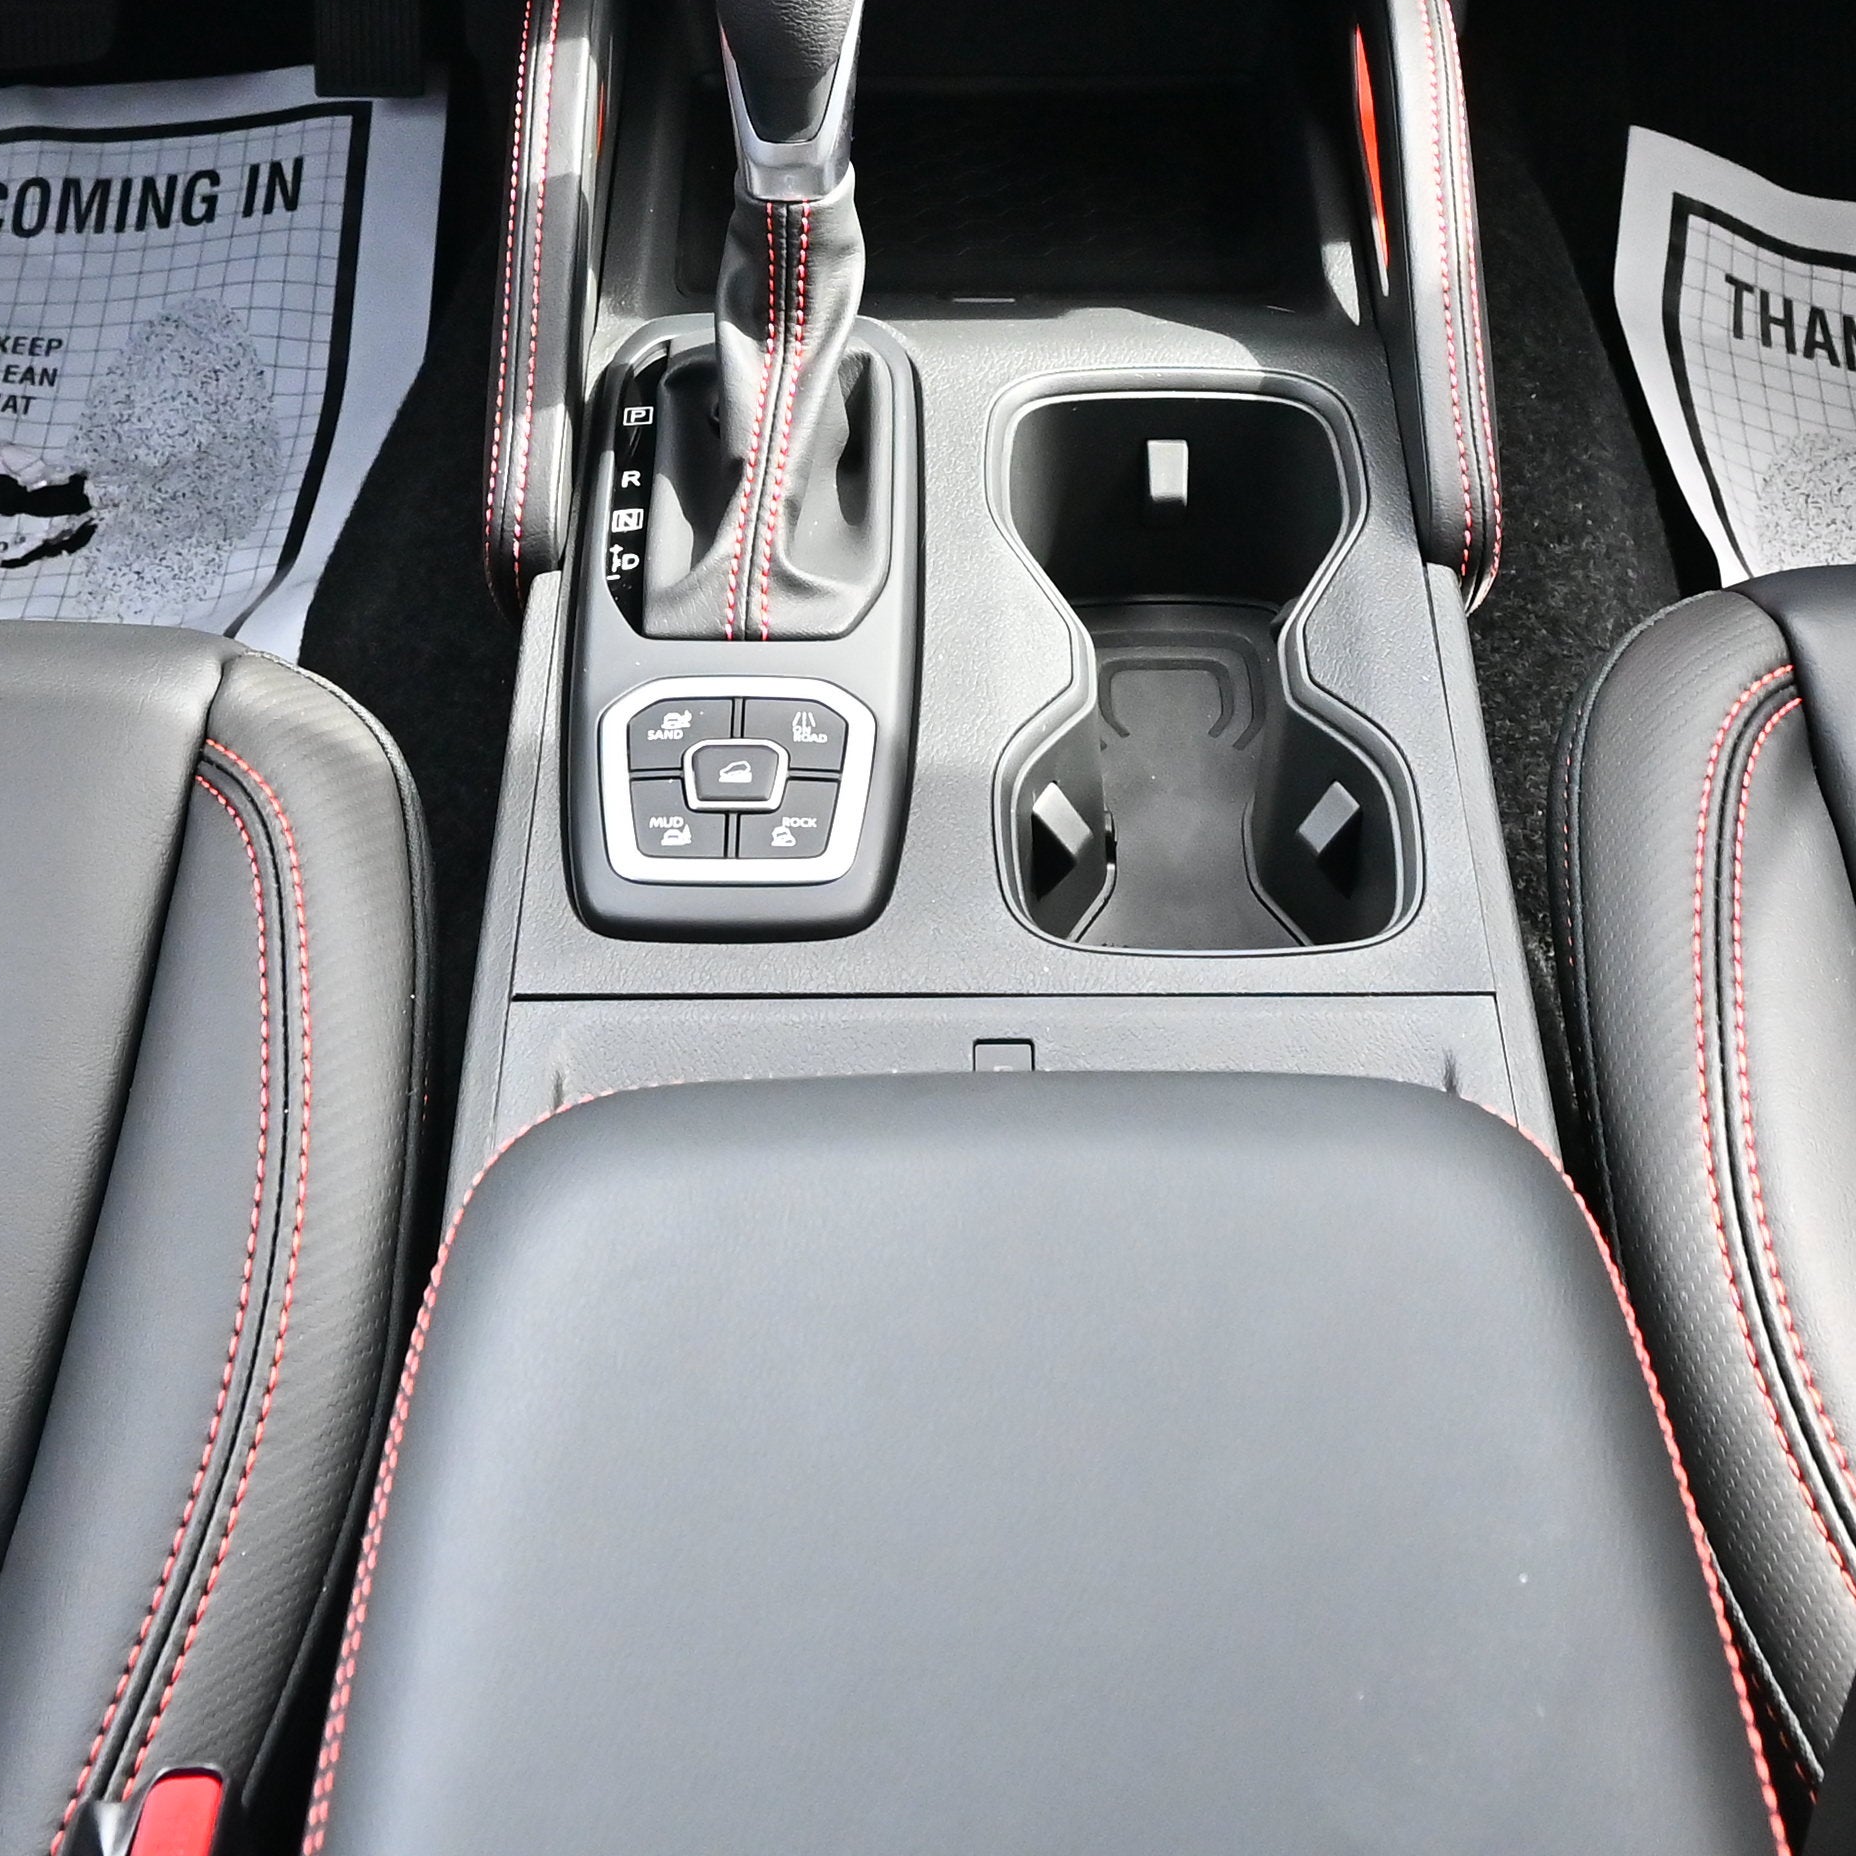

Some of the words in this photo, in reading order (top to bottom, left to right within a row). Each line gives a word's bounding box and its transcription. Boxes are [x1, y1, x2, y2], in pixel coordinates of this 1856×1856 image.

[242, 157, 303, 220] IN
[621, 470, 641, 488] R
[621, 554, 640, 571] D
[647, 730, 684, 740] SAND
[793, 733, 828, 743] ROAD
[649, 816, 684, 828] MUD
[782, 817, 818, 828] ROCK
